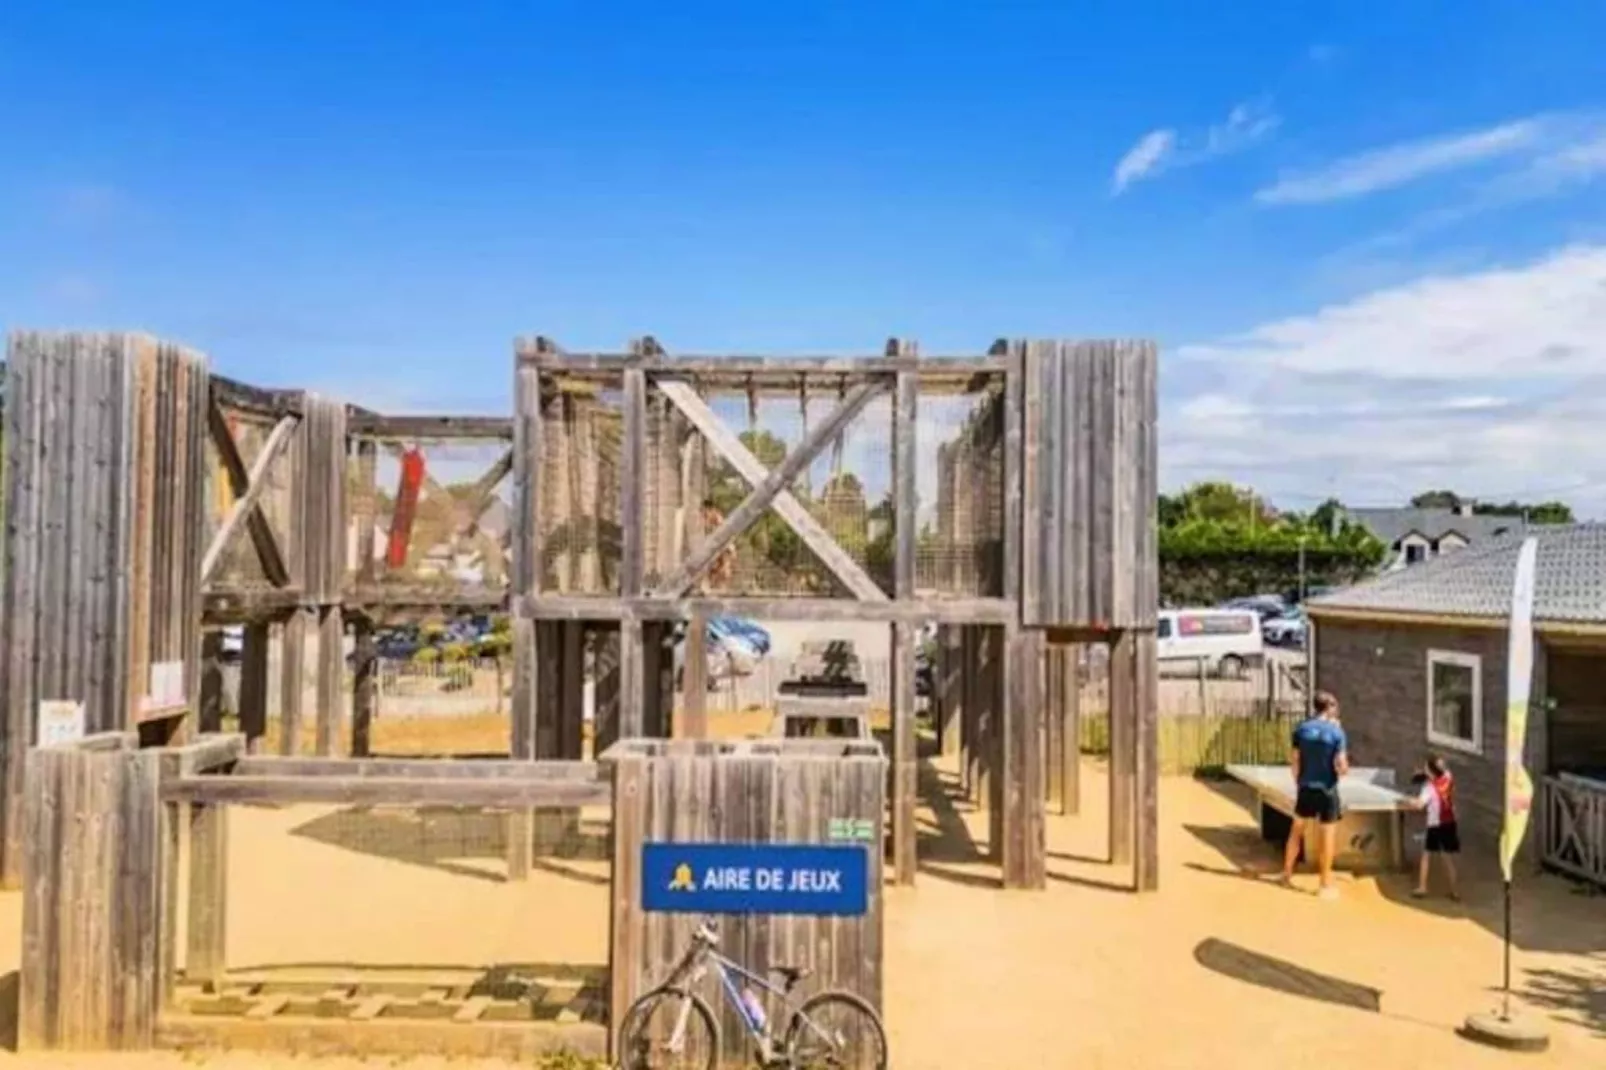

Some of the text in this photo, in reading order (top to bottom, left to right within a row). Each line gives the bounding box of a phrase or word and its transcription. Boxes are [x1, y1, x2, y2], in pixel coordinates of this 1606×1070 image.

[704, 867, 842, 892] AIRE DE JEUX
